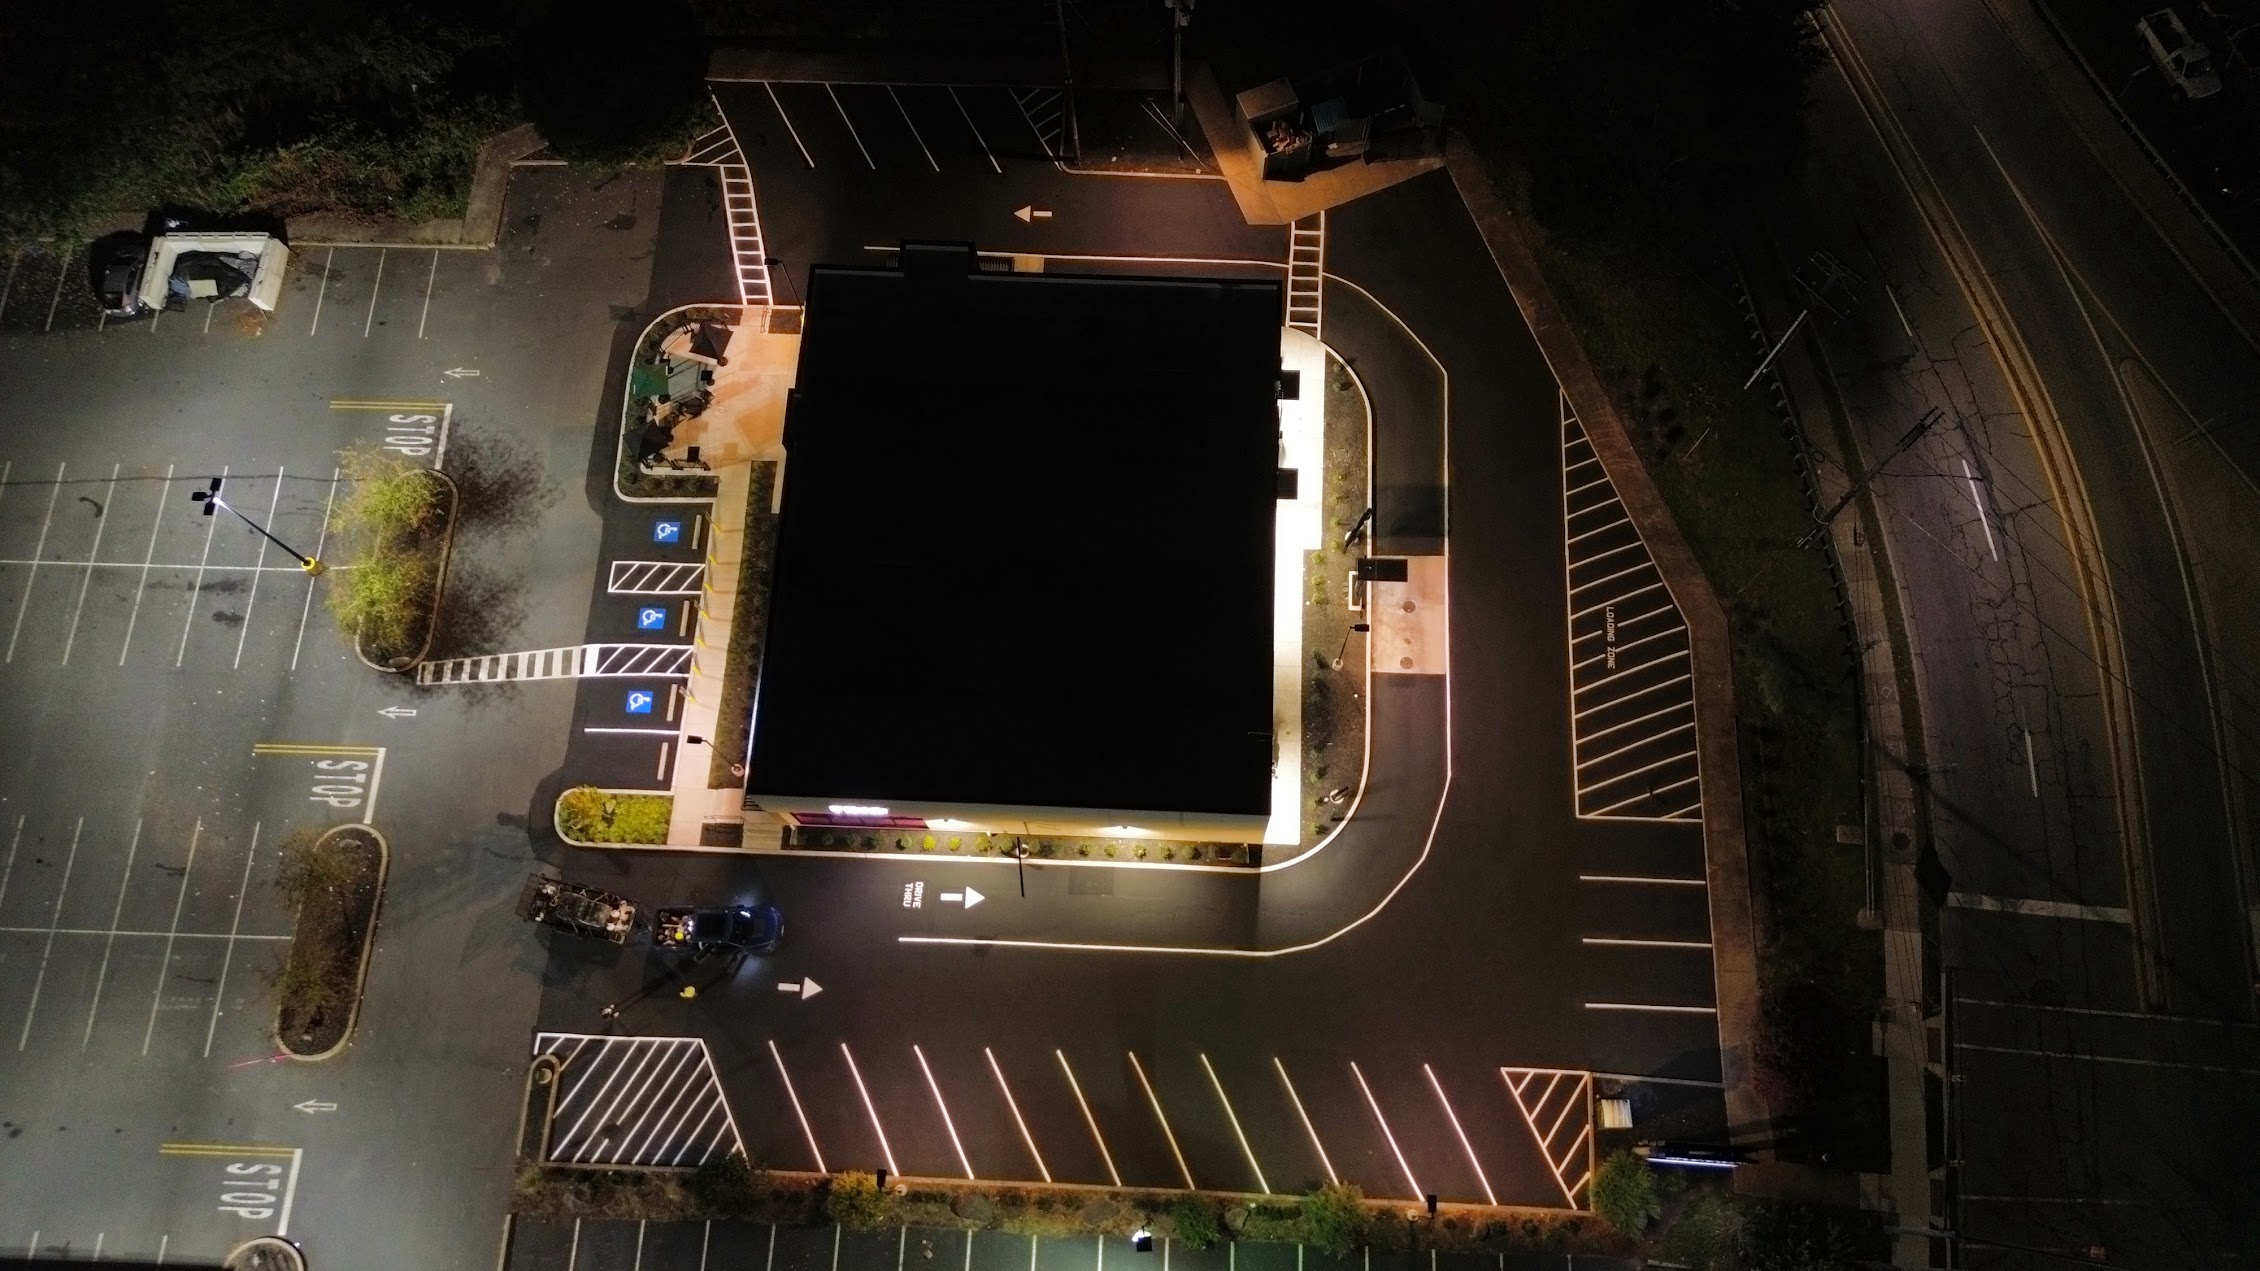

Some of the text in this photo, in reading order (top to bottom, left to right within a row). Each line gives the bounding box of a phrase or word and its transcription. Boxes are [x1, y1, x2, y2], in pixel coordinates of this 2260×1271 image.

[383, 414, 437, 456] STOP
[1606, 606, 1616, 670] LOADING ZONE
[309, 760, 369, 808] STOP
[903, 882, 914, 908] THRU
[912, 881, 924, 909] DRIVE
[217, 1162, 282, 1219] STOP
